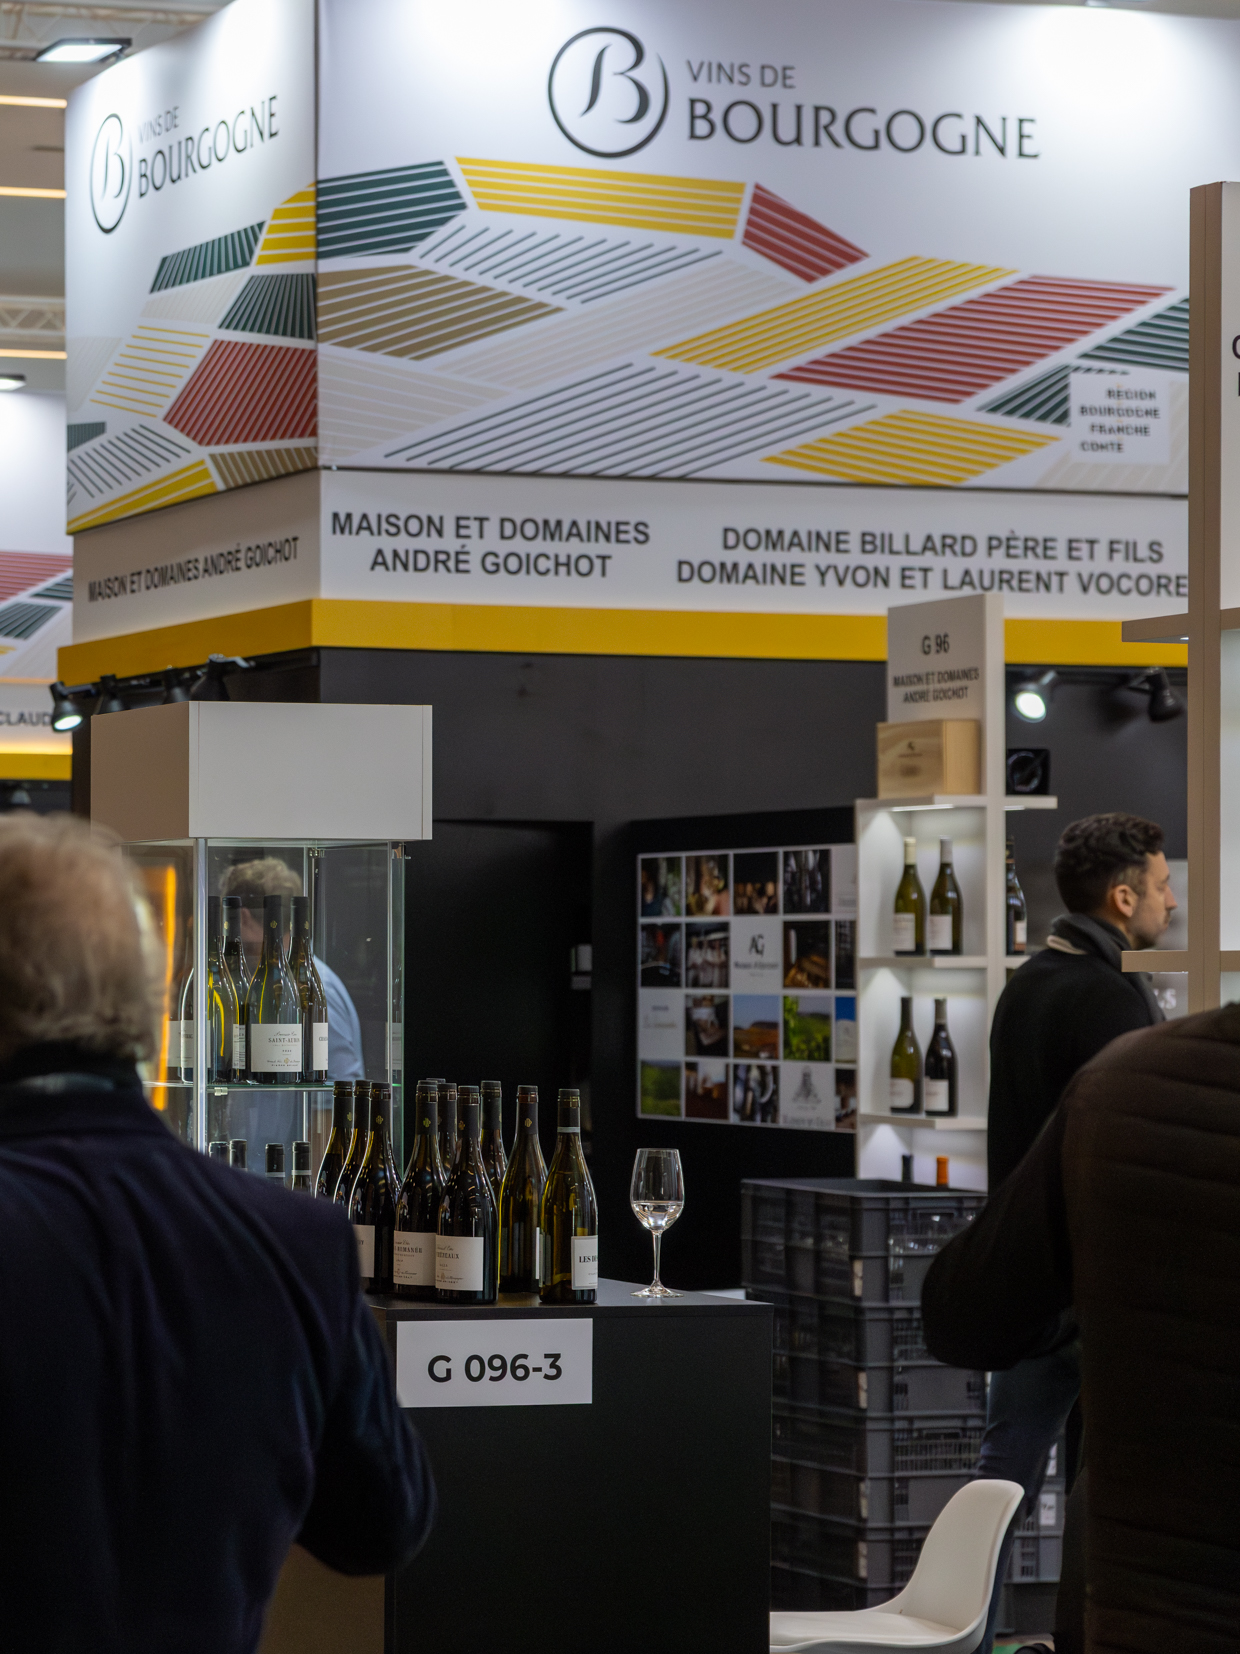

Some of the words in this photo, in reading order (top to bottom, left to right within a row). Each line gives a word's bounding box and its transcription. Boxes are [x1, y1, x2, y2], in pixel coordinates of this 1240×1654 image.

[687, 59, 751, 87] VINS
[760, 64, 796, 89] DE
[139, 115, 162, 144] VINS
[165, 106, 179, 132] DE
[688, 98, 1041, 160] BOURGOGNE
[138, 95, 279, 199] BOURGOGNE
[1080, 406, 1161, 419] BOURGOGNE
[1091, 424, 1151, 436] FRANCHE
[331, 511, 444, 539] MAISON
[455, 516, 490, 540] ET
[499, 517, 650, 545] DOMAINES
[370, 544, 471, 574] ANDRÉ
[481, 551, 613, 578] GOICHOT
[723, 527, 852, 555] DOMAINE
[861, 531, 978, 557] BILLARD
[988, 529, 1058, 560] PÈRE
[1067, 538, 1101, 562] ET
[1108, 539, 1164, 564] FILS
[88, 575, 127, 602] MAISON
[130, 570, 143, 594] ET
[145, 558, 200, 591] DOMAINES
[201, 544, 242, 579] ANDRÉ
[244, 536, 299, 569] GOICHOT
[677, 560, 807, 586] DOMAINE
[814, 564, 890, 589] YVON
[901, 567, 934, 590] ET
[943, 568, 1070, 594] LAURENT
[922, 635, 931, 655] G
[935, 632, 950, 654] 96
[893, 674, 923, 687] MAISON
[925, 671, 935, 685] ET
[937, 667, 979, 684] DOMAINES
[933, 686, 969, 702] GOICHOT
[427, 1354, 452, 1383] G
[464, 1353, 563, 1383] 096-3
